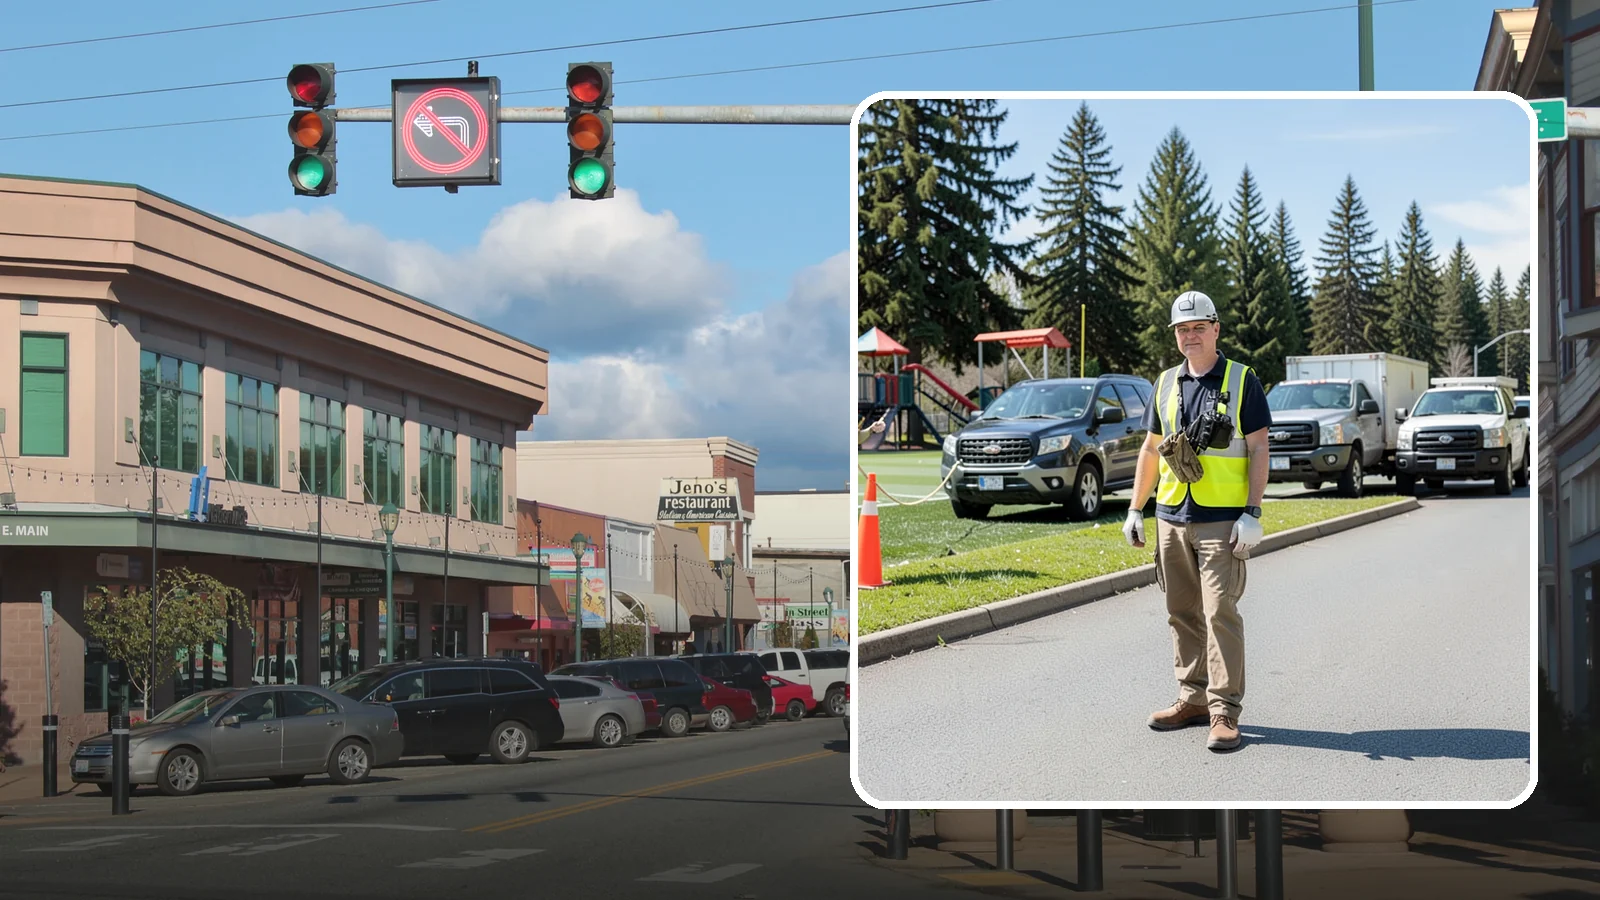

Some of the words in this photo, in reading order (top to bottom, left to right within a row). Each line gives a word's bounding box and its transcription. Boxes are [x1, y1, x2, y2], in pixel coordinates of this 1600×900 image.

[670, 480, 727, 494] Jeno's
[665, 497, 731, 508] restaurant
[659, 510, 681, 519] Italian
[686, 510, 714, 519] American
[715, 509, 737, 519] Cuisine
[2, 525, 12, 536] E.
[16, 525, 48, 536] MAIN
[786, 608, 794, 616] in
[797, 608, 828, 616] Street
